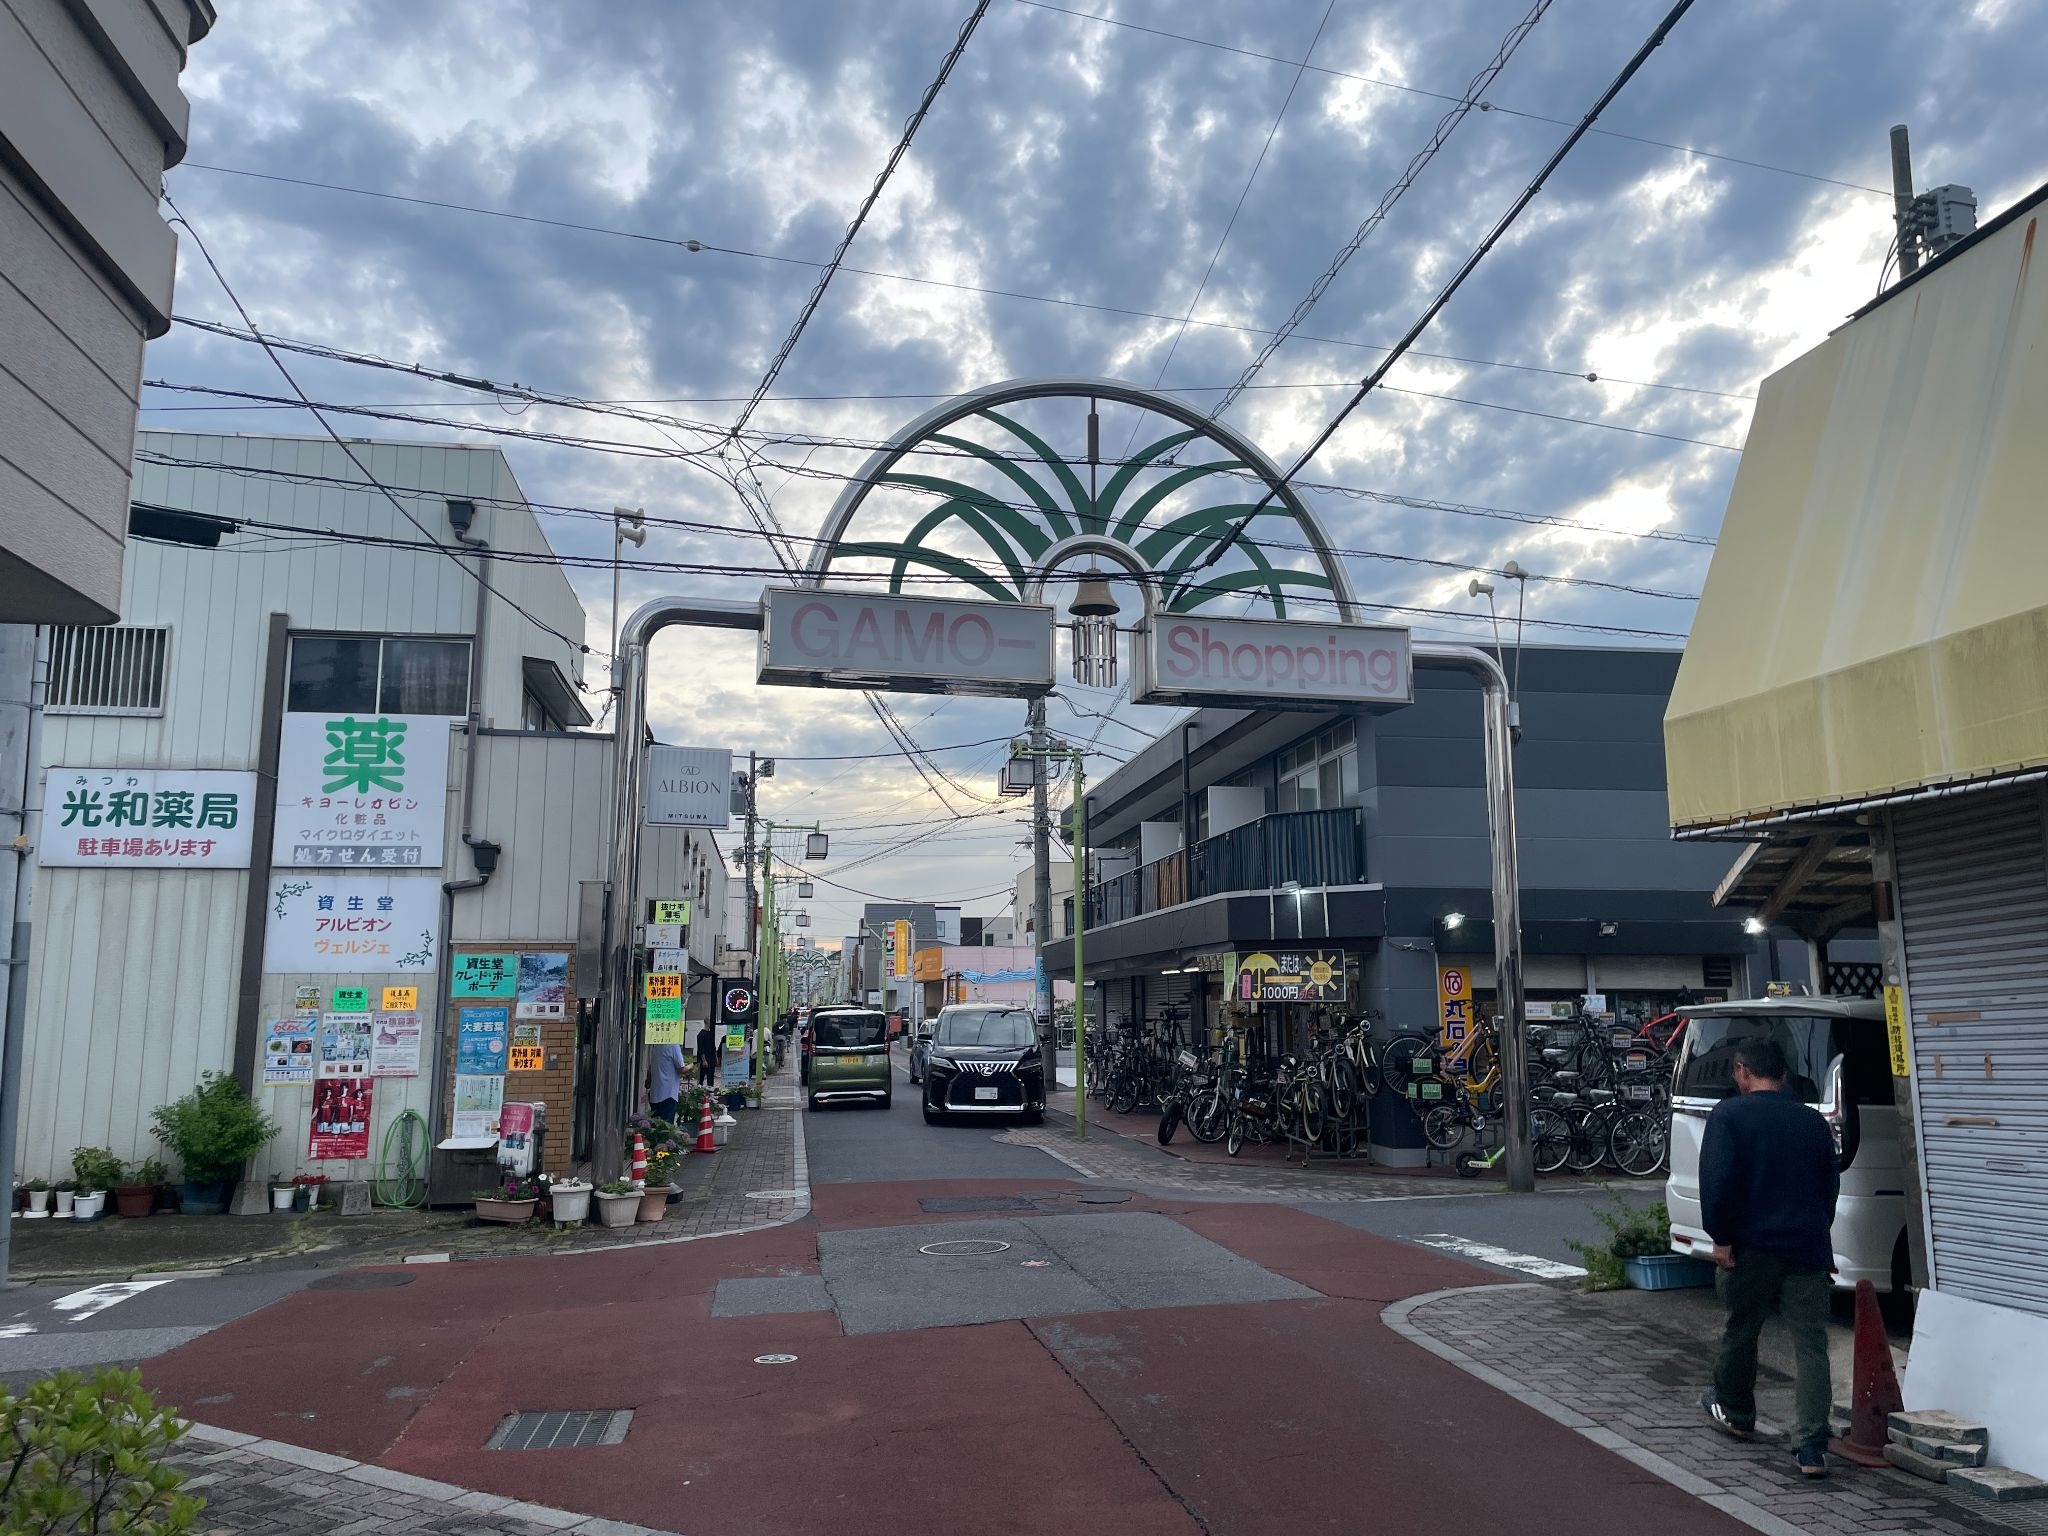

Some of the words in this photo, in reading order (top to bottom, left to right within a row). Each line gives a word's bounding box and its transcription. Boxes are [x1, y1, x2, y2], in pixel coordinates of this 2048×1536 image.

[1166, 625, 1398, 694] Shopping
[322, 717, 408, 794] 薬
[76, 775, 138, 786] みつわ
[658, 779, 721, 794] ALBION
[61, 789, 239, 829] 光和薬局
[335, 813, 386, 825] 化粧品
[299, 829, 421, 842] マイクロダイエット
[77, 838, 217, 857] 駐車場あります
[295, 847, 420, 864] 処方せん受付
[317, 895, 394, 911] 資生堂
[315, 917, 392, 932] アルビオン
[314, 939, 391, 954] ヴェルジェ
[466, 957, 504, 970] 資生堂
[1280, 955, 1300, 973] または
[338, 990, 363, 999] 資生堂
[462, 1022, 504, 1032] 大麦若葉
